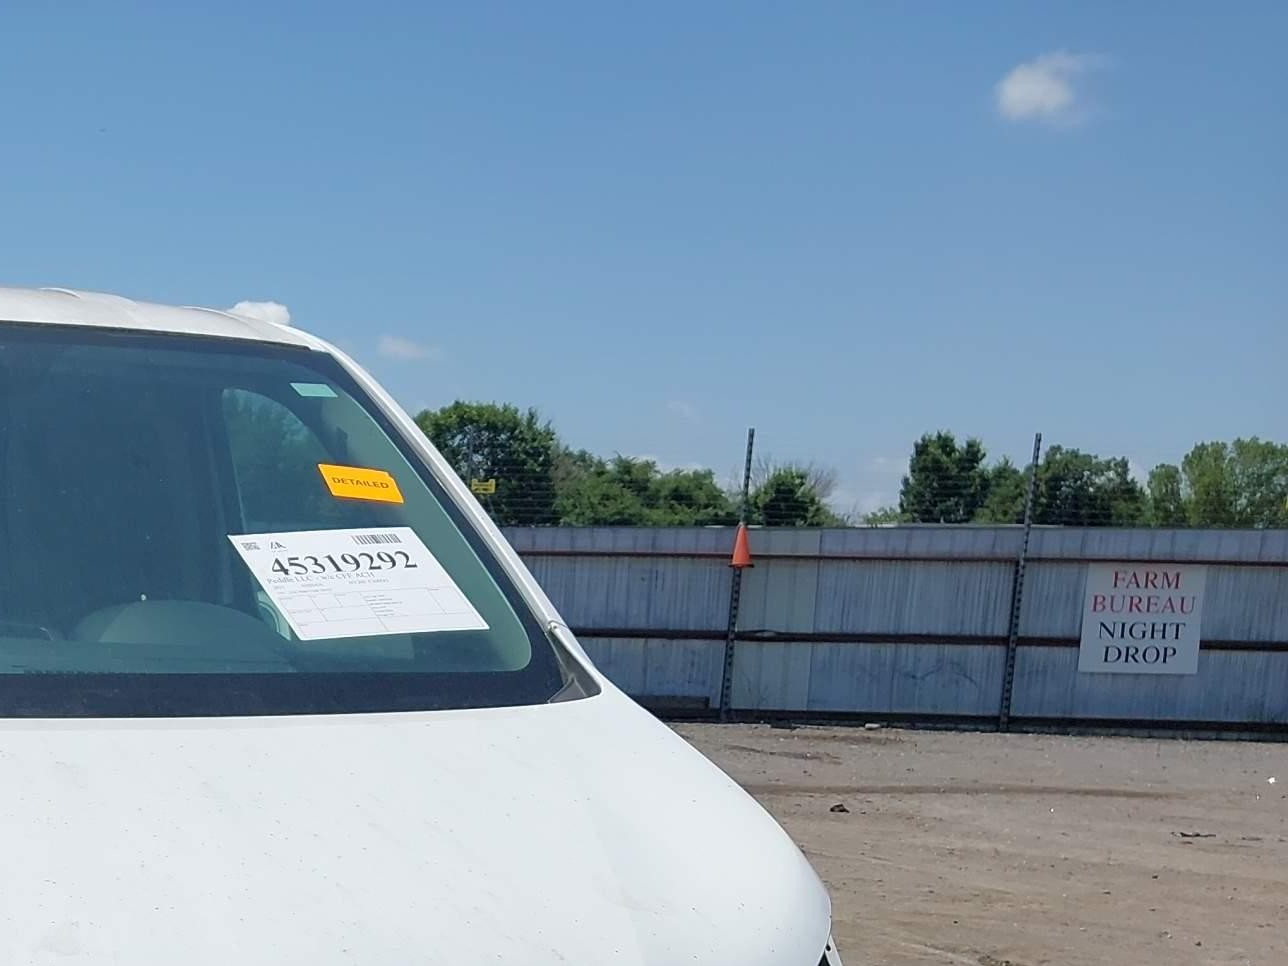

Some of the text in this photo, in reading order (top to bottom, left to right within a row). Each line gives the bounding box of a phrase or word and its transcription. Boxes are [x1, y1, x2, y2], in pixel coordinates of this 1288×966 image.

[332, 477, 389, 489] DETAILED
[272, 551, 417, 575] 45319292
[1113, 571, 1181, 589] FARM
[1092, 594, 1196, 614] BUREAU
[1099, 621, 1186, 640] NIGHT
[1103, 645, 1177, 664] DROP
